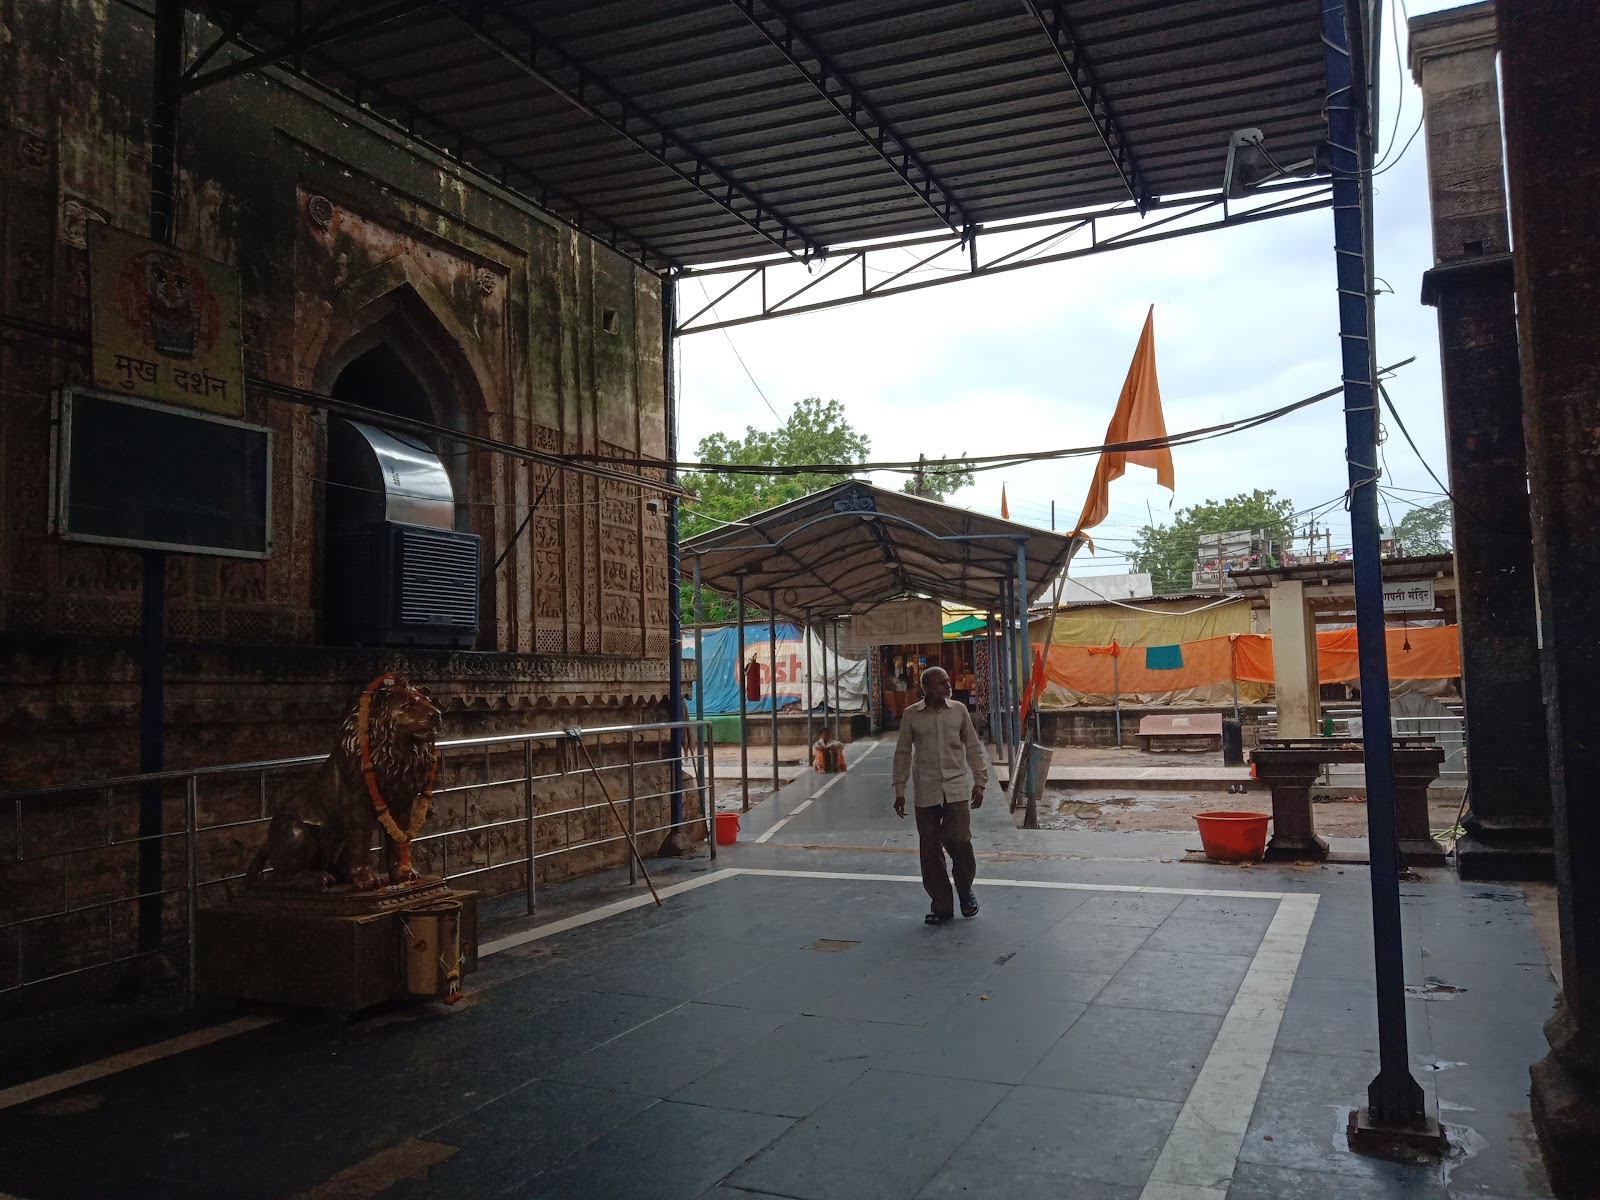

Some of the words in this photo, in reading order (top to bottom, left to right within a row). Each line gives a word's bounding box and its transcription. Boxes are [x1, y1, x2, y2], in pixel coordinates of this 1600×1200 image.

[114, 354, 159, 390] मुख
[173, 368, 228, 400] दर्शन
[1408, 587, 1428, 601] मंदिर
